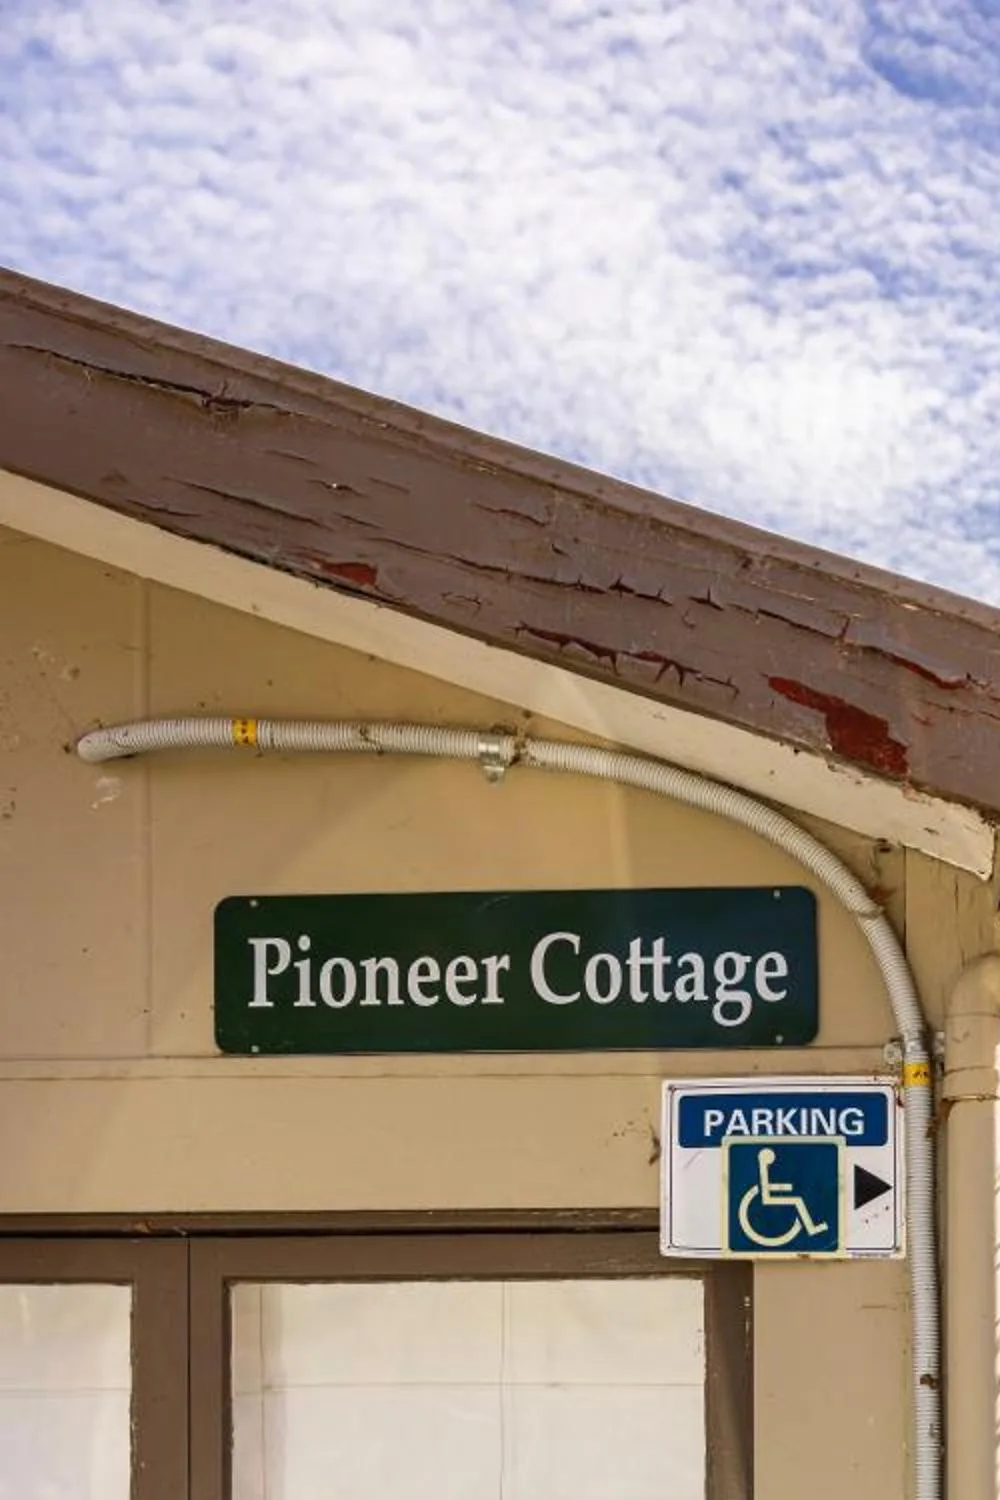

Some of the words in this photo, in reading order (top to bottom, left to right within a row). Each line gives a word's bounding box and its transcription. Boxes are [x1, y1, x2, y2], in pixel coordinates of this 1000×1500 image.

[248, 935, 510, 1008] Pioneer
[530, 931, 788, 1027] Cottage
[704, 1107, 865, 1137] PARKING
